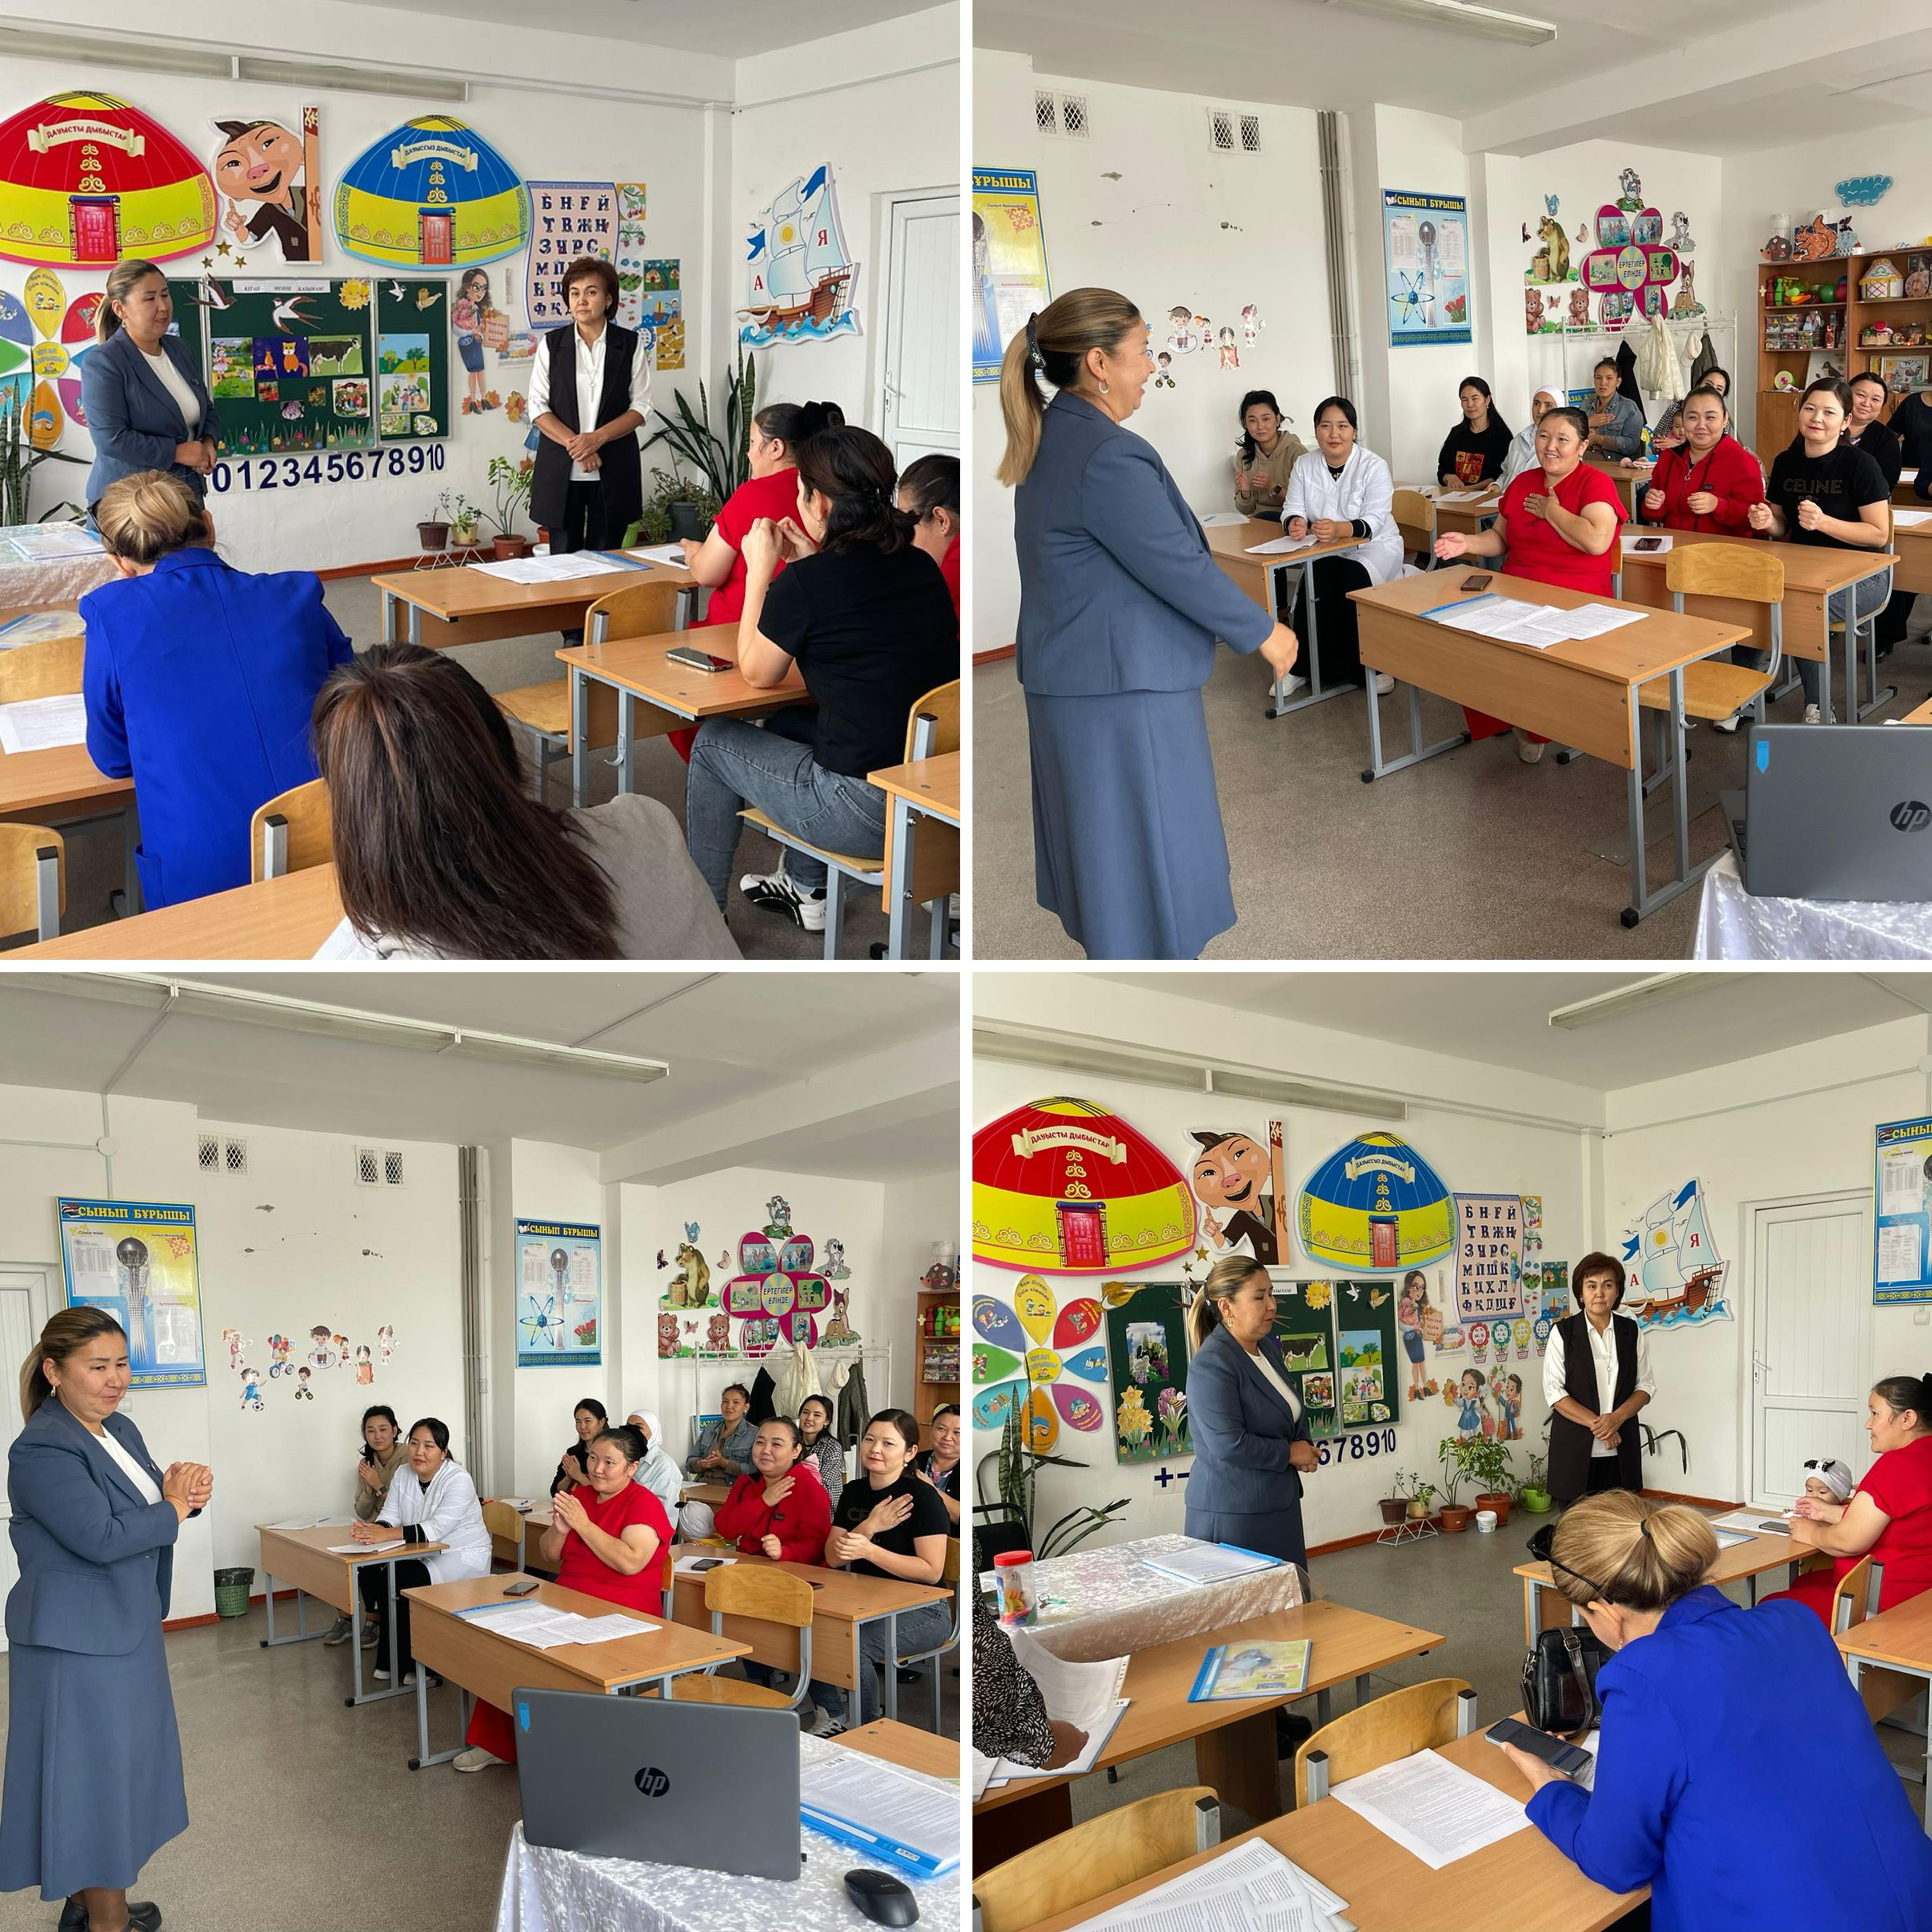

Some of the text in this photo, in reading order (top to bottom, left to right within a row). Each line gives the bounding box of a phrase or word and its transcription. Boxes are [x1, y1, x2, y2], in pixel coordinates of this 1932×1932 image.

[47, 125, 128, 140] ДАУЫСТЫ ДЫБЫСТАР
[973, 176, 1031, 188] ҰРЫШЫ
[542, 196, 552, 209] Б
[561, 196, 572, 209] Н
[597, 195, 609, 211] Й
[1397, 196, 1463, 210] СЫНЫП БҰРЫШЫ
[543, 216, 555, 232] Т
[577, 218, 592, 232] Ж
[1783, 478, 1843, 494] CELINE
[1893, 801, 1929, 832] hp
[1030, 1131, 1110, 1148] ДАУЫСТЫ ДЫБЫСТАР
[1356, 1159, 1405, 1172] ДАУЫССЫЗ ДЫБЫСТАР
[78, 1207, 190, 1221] СЫНЫП БҰРЫШЫ
[1465, 1206, 1473, 1218] Б
[1480, 1207, 1488, 1219] Н
[1508, 1205, 1516, 1220] Й
[530, 1225, 598, 1237] СЫНЫП БҰРЫШЫ
[1467, 1224, 1475, 1238] Т
[1493, 1226, 1504, 1238] Ж
[1487, 1264, 1498, 1275] Ш
[769, 1297, 788, 1305] ЕЛІНДЕ
[638, 1767, 667, 1797] hp
